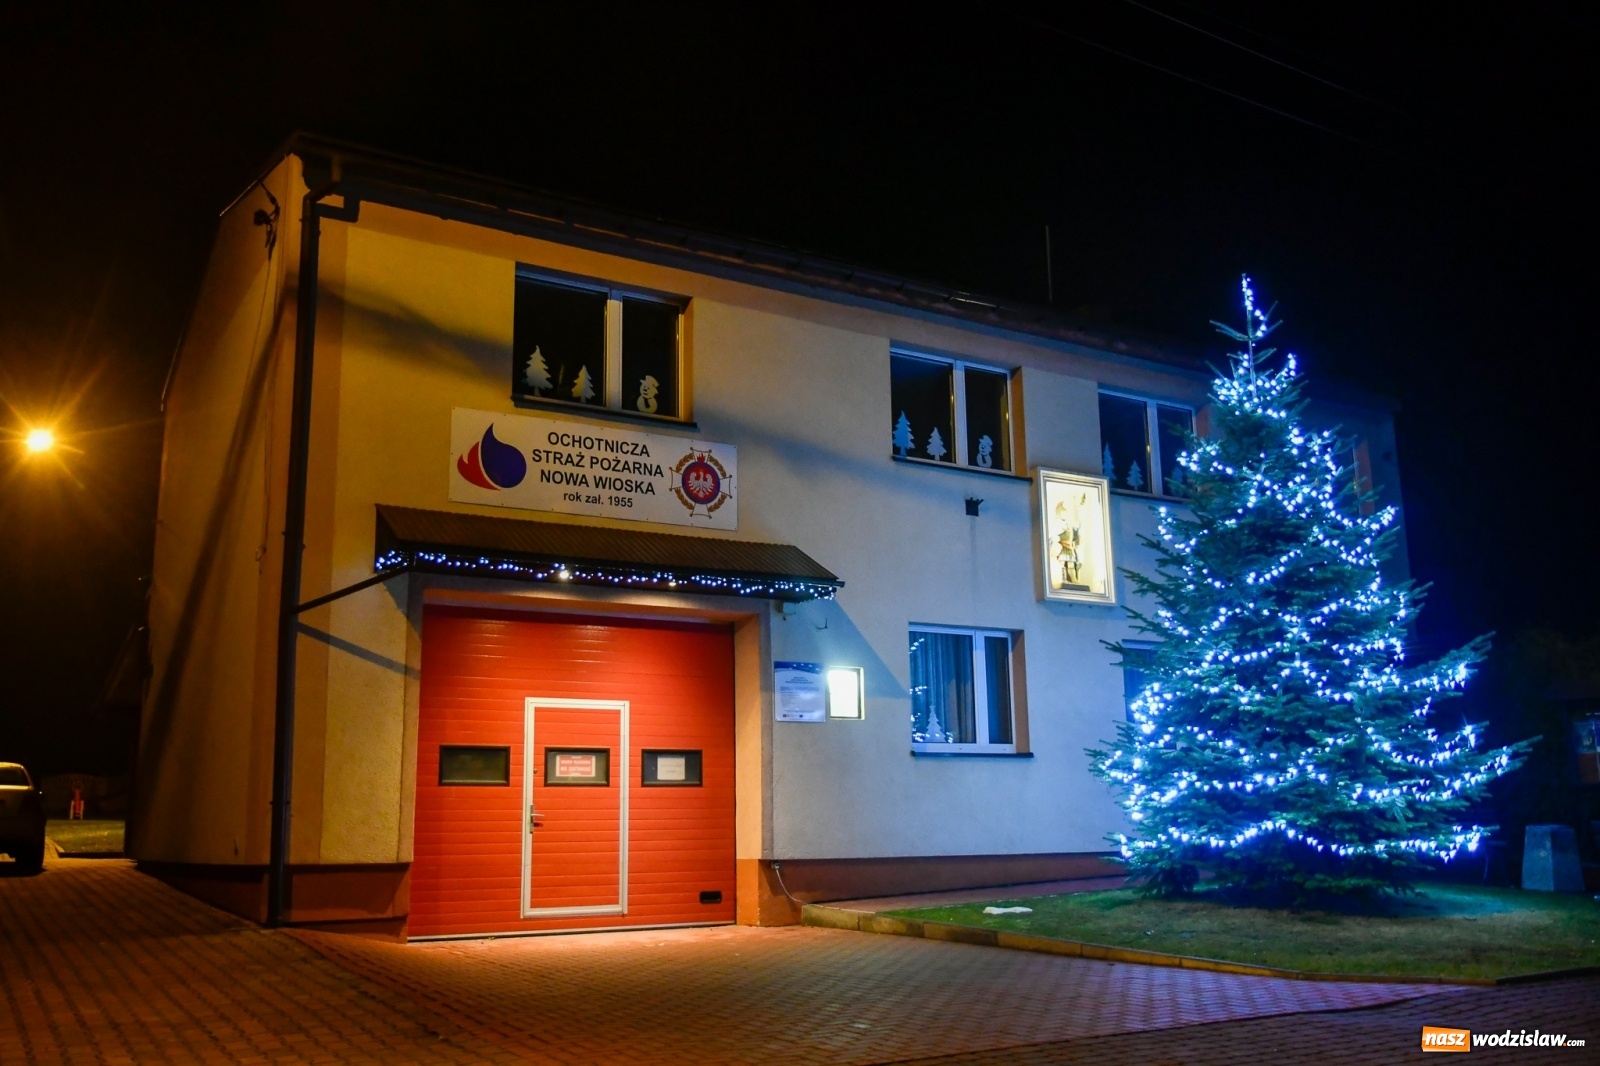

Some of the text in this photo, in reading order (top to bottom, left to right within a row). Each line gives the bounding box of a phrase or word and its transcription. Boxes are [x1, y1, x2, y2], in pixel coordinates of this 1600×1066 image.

[547, 431, 650, 457] OCHOTNICZA
[532, 448, 664, 478] STRAŻ POŻARNA
[540, 469, 655, 495] NOWA WIOSKA
[563, 491, 633, 508] rok zał. 1955
